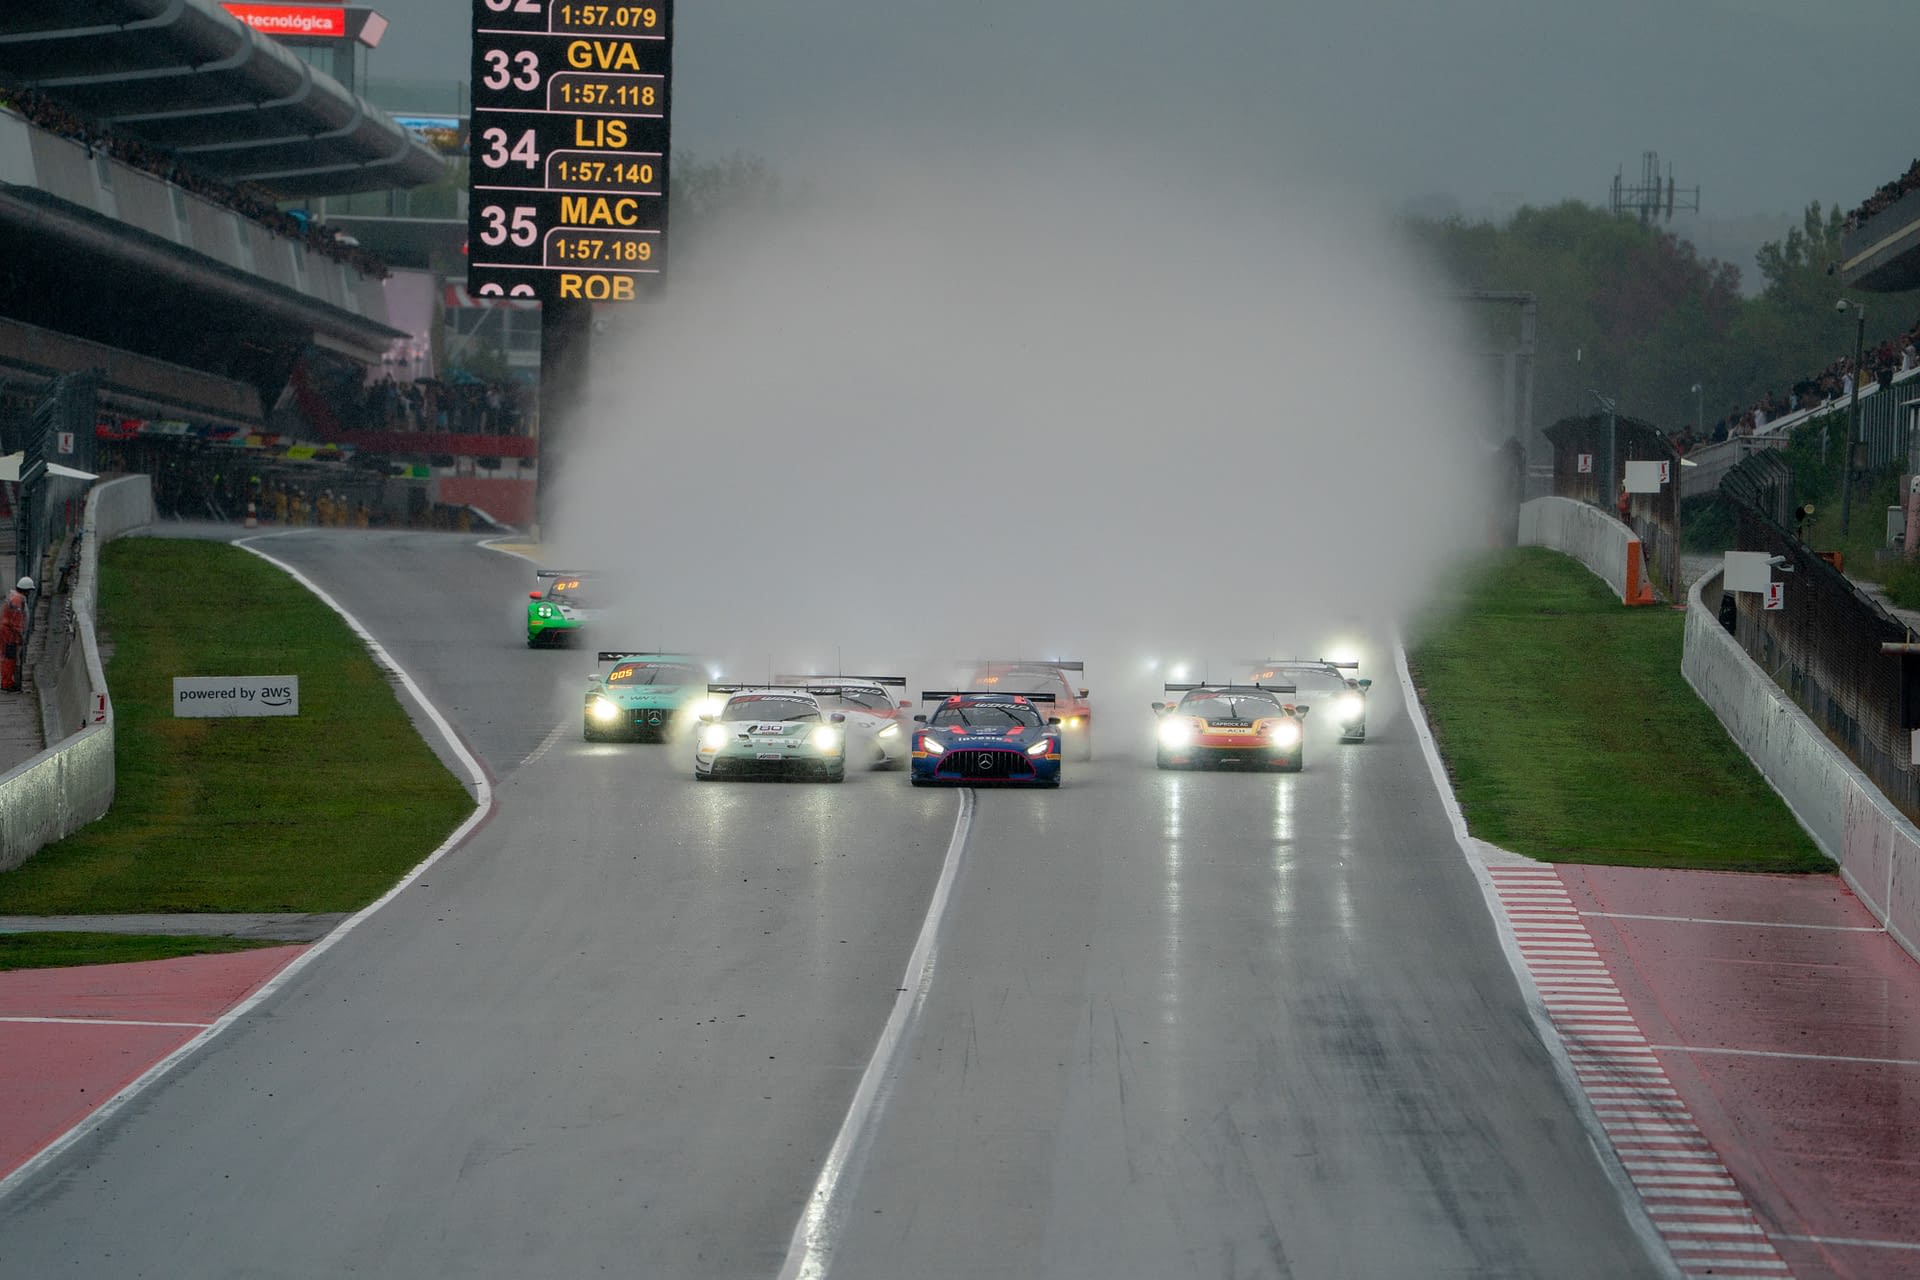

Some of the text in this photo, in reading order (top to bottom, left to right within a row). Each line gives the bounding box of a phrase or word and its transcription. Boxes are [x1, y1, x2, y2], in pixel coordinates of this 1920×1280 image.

[248, 14, 332, 30] tecnológica
[561, 5, 656, 28] 1:57.079
[567, 40, 640, 70] GVA
[483, 49, 540, 91] 33
[561, 83, 655, 106] 1:57.118
[575, 119, 628, 148] LIS
[482, 127, 540, 169] 34
[558, 161, 653, 184] 1:57.140
[560, 196, 638, 225] MAC
[480, 205, 538, 247] 35
[556, 239, 651, 261] 1:57.189
[560, 274, 635, 300] ROB
[180, 687, 291, 701] powered by aws
